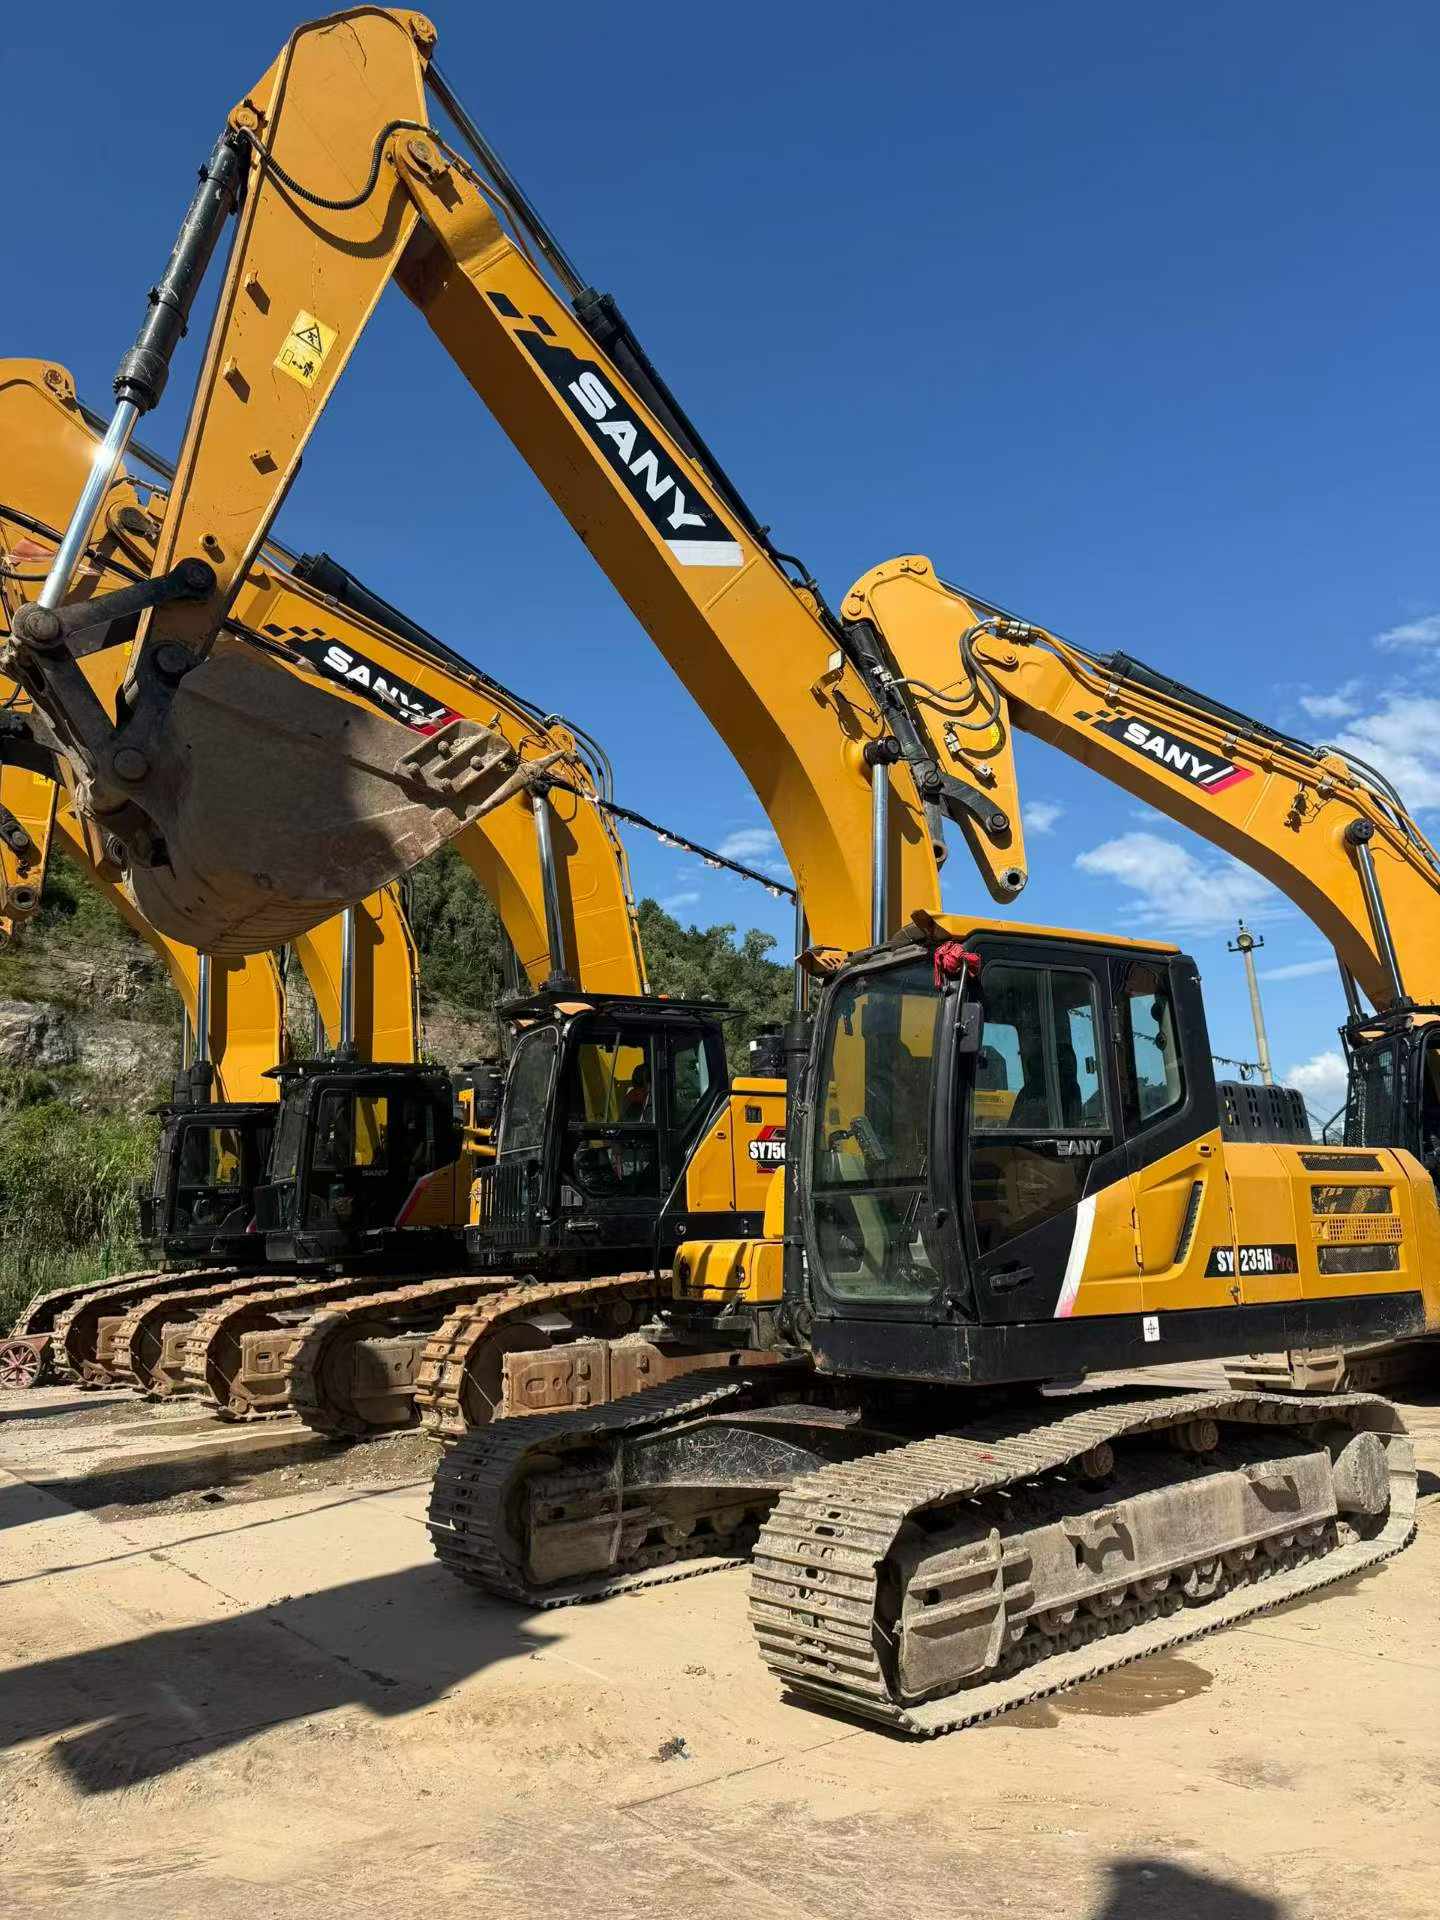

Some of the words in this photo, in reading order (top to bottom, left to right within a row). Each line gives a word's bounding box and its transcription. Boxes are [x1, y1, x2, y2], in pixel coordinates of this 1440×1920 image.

[567, 371, 706, 530] SANY
[1122, 722, 1214, 779] SANY
[1056, 1139, 1101, 1156] SANY
